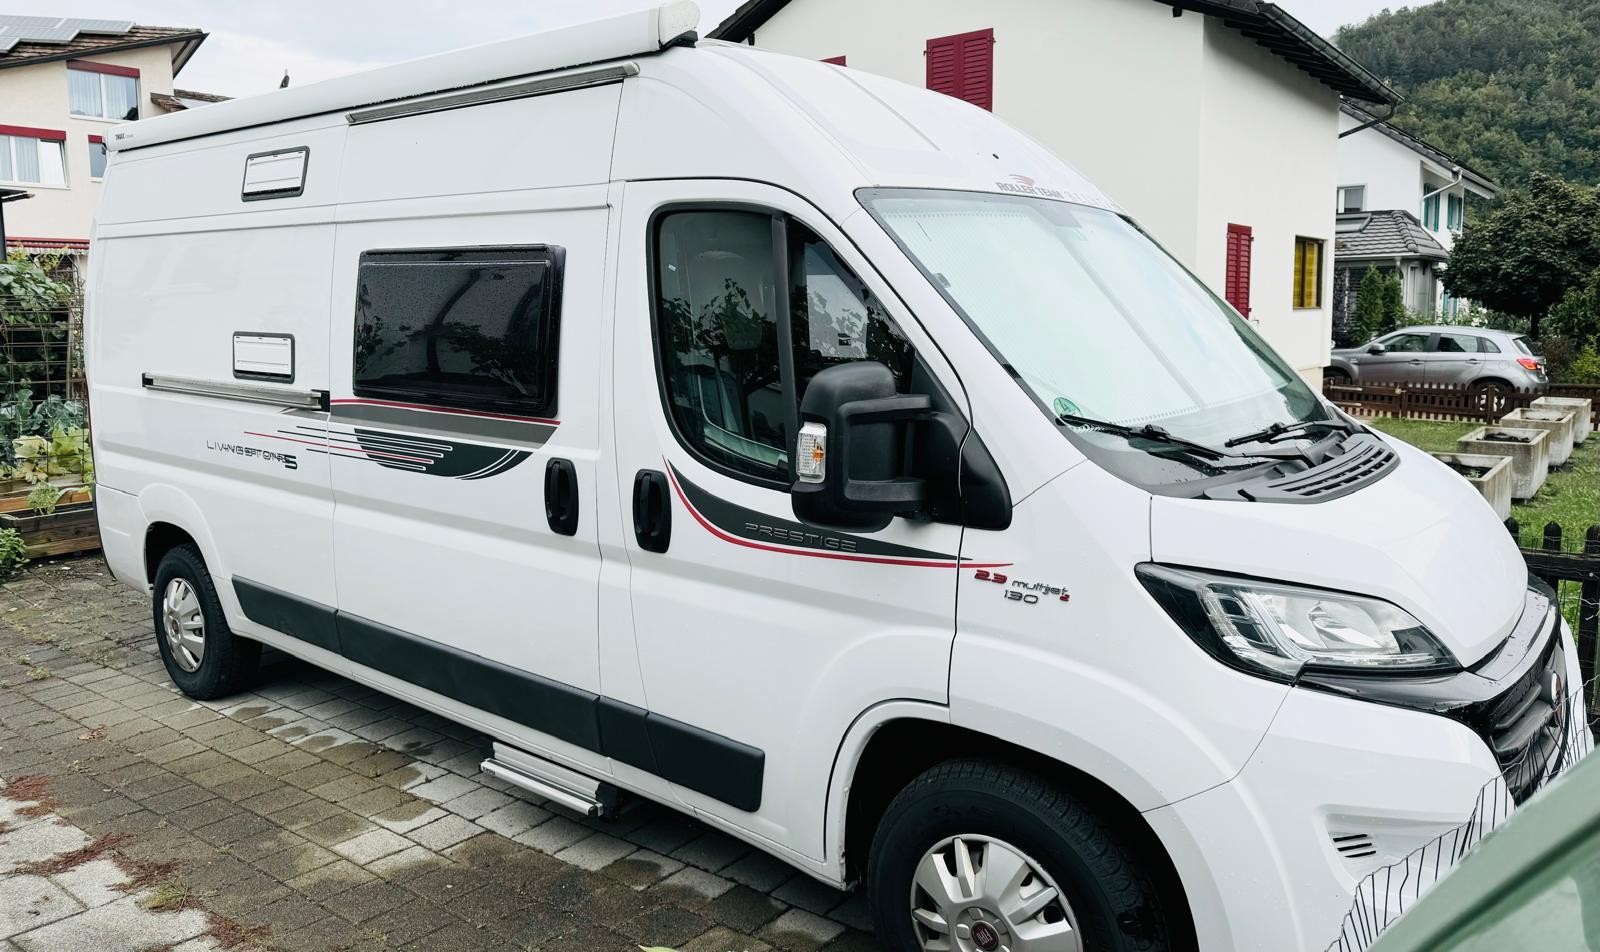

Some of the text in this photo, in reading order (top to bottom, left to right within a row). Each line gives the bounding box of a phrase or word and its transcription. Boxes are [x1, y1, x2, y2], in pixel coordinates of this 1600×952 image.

[995, 182, 1037, 195] ROLLER
[745, 522, 857, 552] PRESTIGE
[974, 569, 1008, 585] 2.3
[1003, 589, 1039, 604] 130
